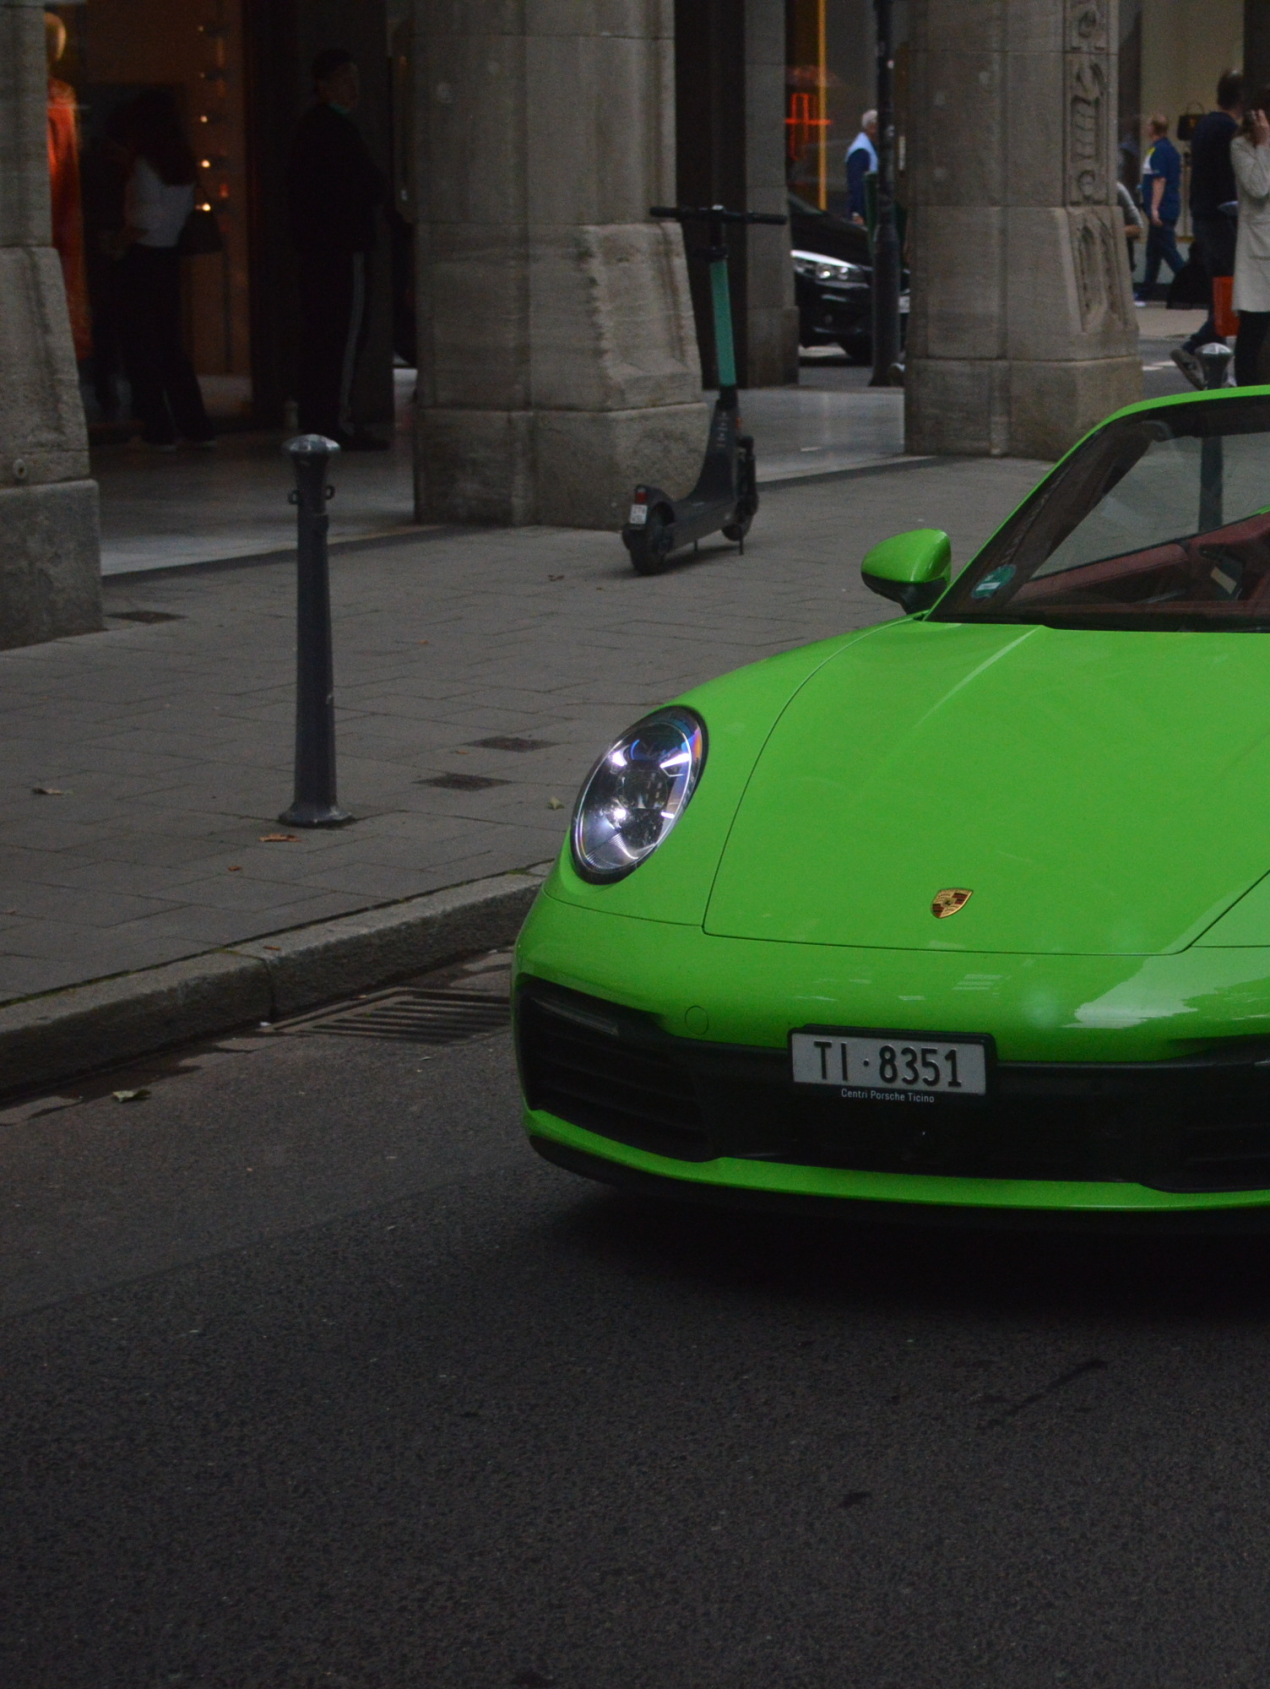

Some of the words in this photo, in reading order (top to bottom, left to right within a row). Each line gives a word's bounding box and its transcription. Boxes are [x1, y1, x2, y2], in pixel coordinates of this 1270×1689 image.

[841, 1088, 868, 1099] Centri
[870, 1090, 905, 1101] Porsche
[908, 1091, 935, 1103] Ticino
